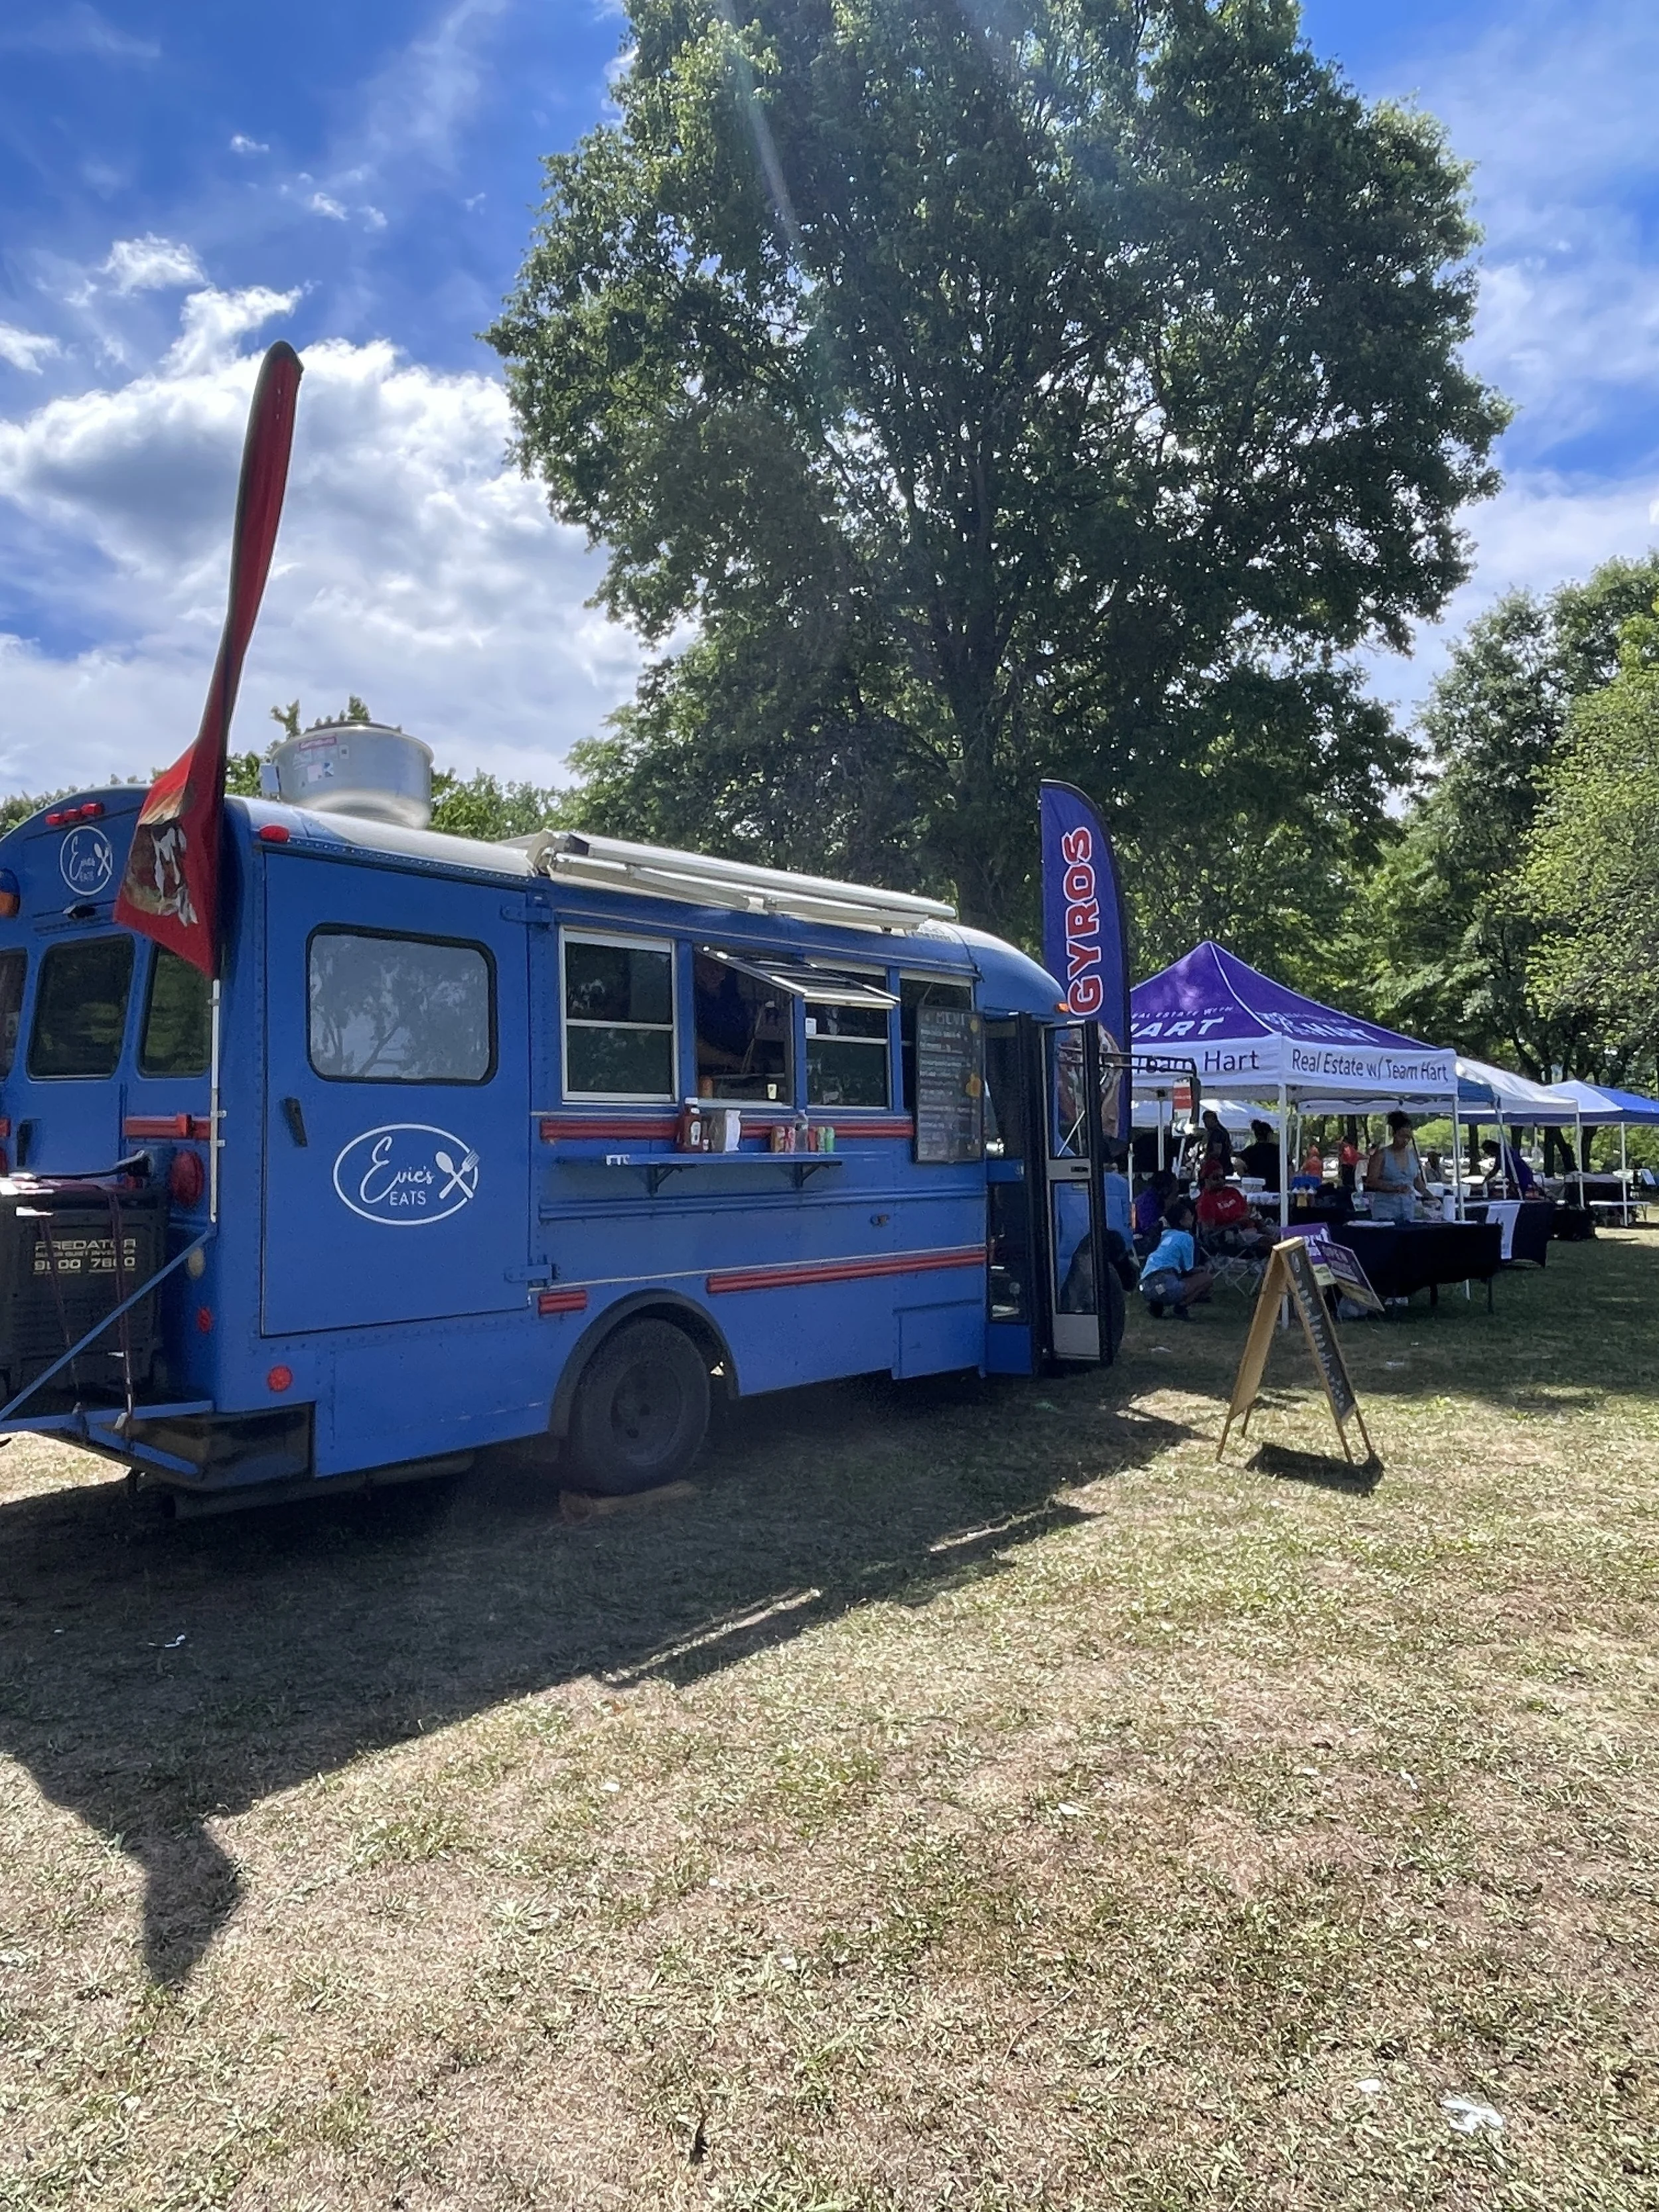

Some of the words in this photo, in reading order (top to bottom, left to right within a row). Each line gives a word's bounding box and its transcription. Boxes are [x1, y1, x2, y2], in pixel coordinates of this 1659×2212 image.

[1062, 827, 1103, 1016] GYROS
[1204, 1050, 1260, 1071] Hart
[1292, 1048, 1321, 1072] Real
[1323, 1052, 1364, 1076] Estate
[1366, 1056, 1384, 1081] w/
[1385, 1059, 1418, 1080] Team
[1421, 1061, 1449, 1082] Hart
[360, 1136, 436, 1204] Evie's
[389, 1190, 427, 1207] EATS
